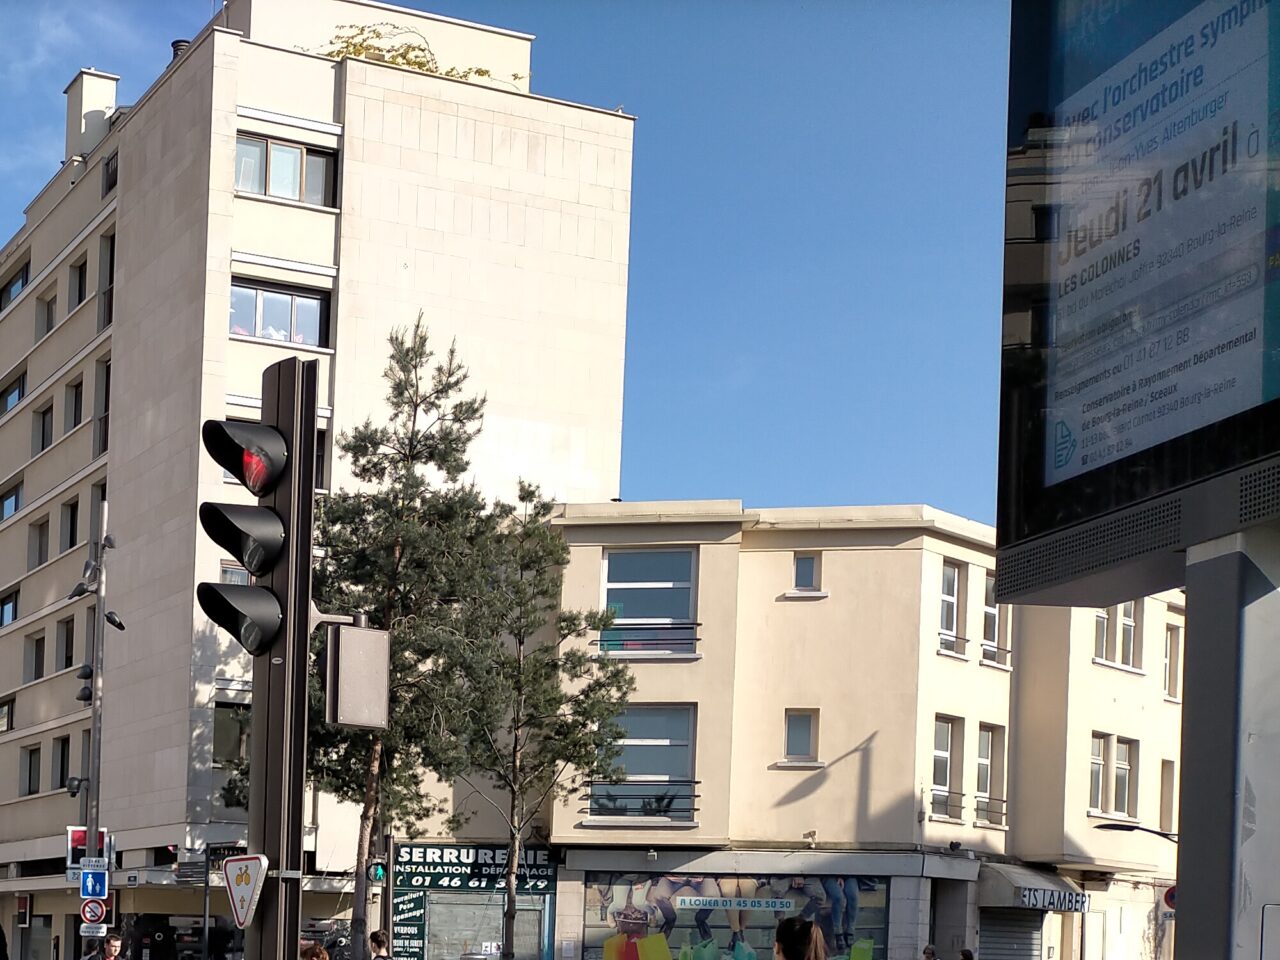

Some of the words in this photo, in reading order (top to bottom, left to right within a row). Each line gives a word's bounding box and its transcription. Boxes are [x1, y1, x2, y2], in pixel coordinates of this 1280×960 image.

[1103, 34, 1195, 114] l'orchestre
[1086, 64, 1204, 157] conservatoire
[1162, 90, 1229, 145] Altenburger
[1057, 187, 1128, 266] Jeudi
[1136, 168, 1163, 223] 21
[1172, 120, 1237, 201] avril
[1156, 243, 1186, 269] 92340
[1187, 205, 1258, 257] Bourg-la-Reine
[1058, 272, 1077, 298] LES
[1080, 238, 1141, 286] COLONNES
[1055, 367, 1111, 401] Renseignements
[1123, 352, 1134, 371] 01
[1149, 339, 1162, 360] 87
[1163, 335, 1173, 353] 12
[1176, 327, 1191, 347] 88
[1082, 383, 1131, 414] Conservatoire
[1138, 357, 1192, 389] Rayonnement
[1193, 327, 1257, 366] Départemental
[1091, 397, 1144, 428] Bourg-la-Reine
[1150, 382, 1178, 403] Sceaux
[1133, 409, 1156, 428] Carnot
[1157, 396, 1179, 419] 92340
[1179, 375, 1237, 412] Bourg-la-Reine
[393, 864, 470, 874] INSTALLATION
[411, 876, 431, 887] 01
[438, 876, 461, 887] 46
[468, 877, 487, 888] 61
[524, 878, 548, 889] 79
[392, 908, 425, 922] épannage
[393, 890, 424, 903] ourniture
[398, 902, 415, 911] Pose
[722, 899, 732, 907] 01
[736, 899, 747, 907] 45
[750, 900, 762, 908] 05
[765, 900, 776, 909] 50
[779, 900, 791, 909] 50
[393, 926, 418, 934] VERROUS
